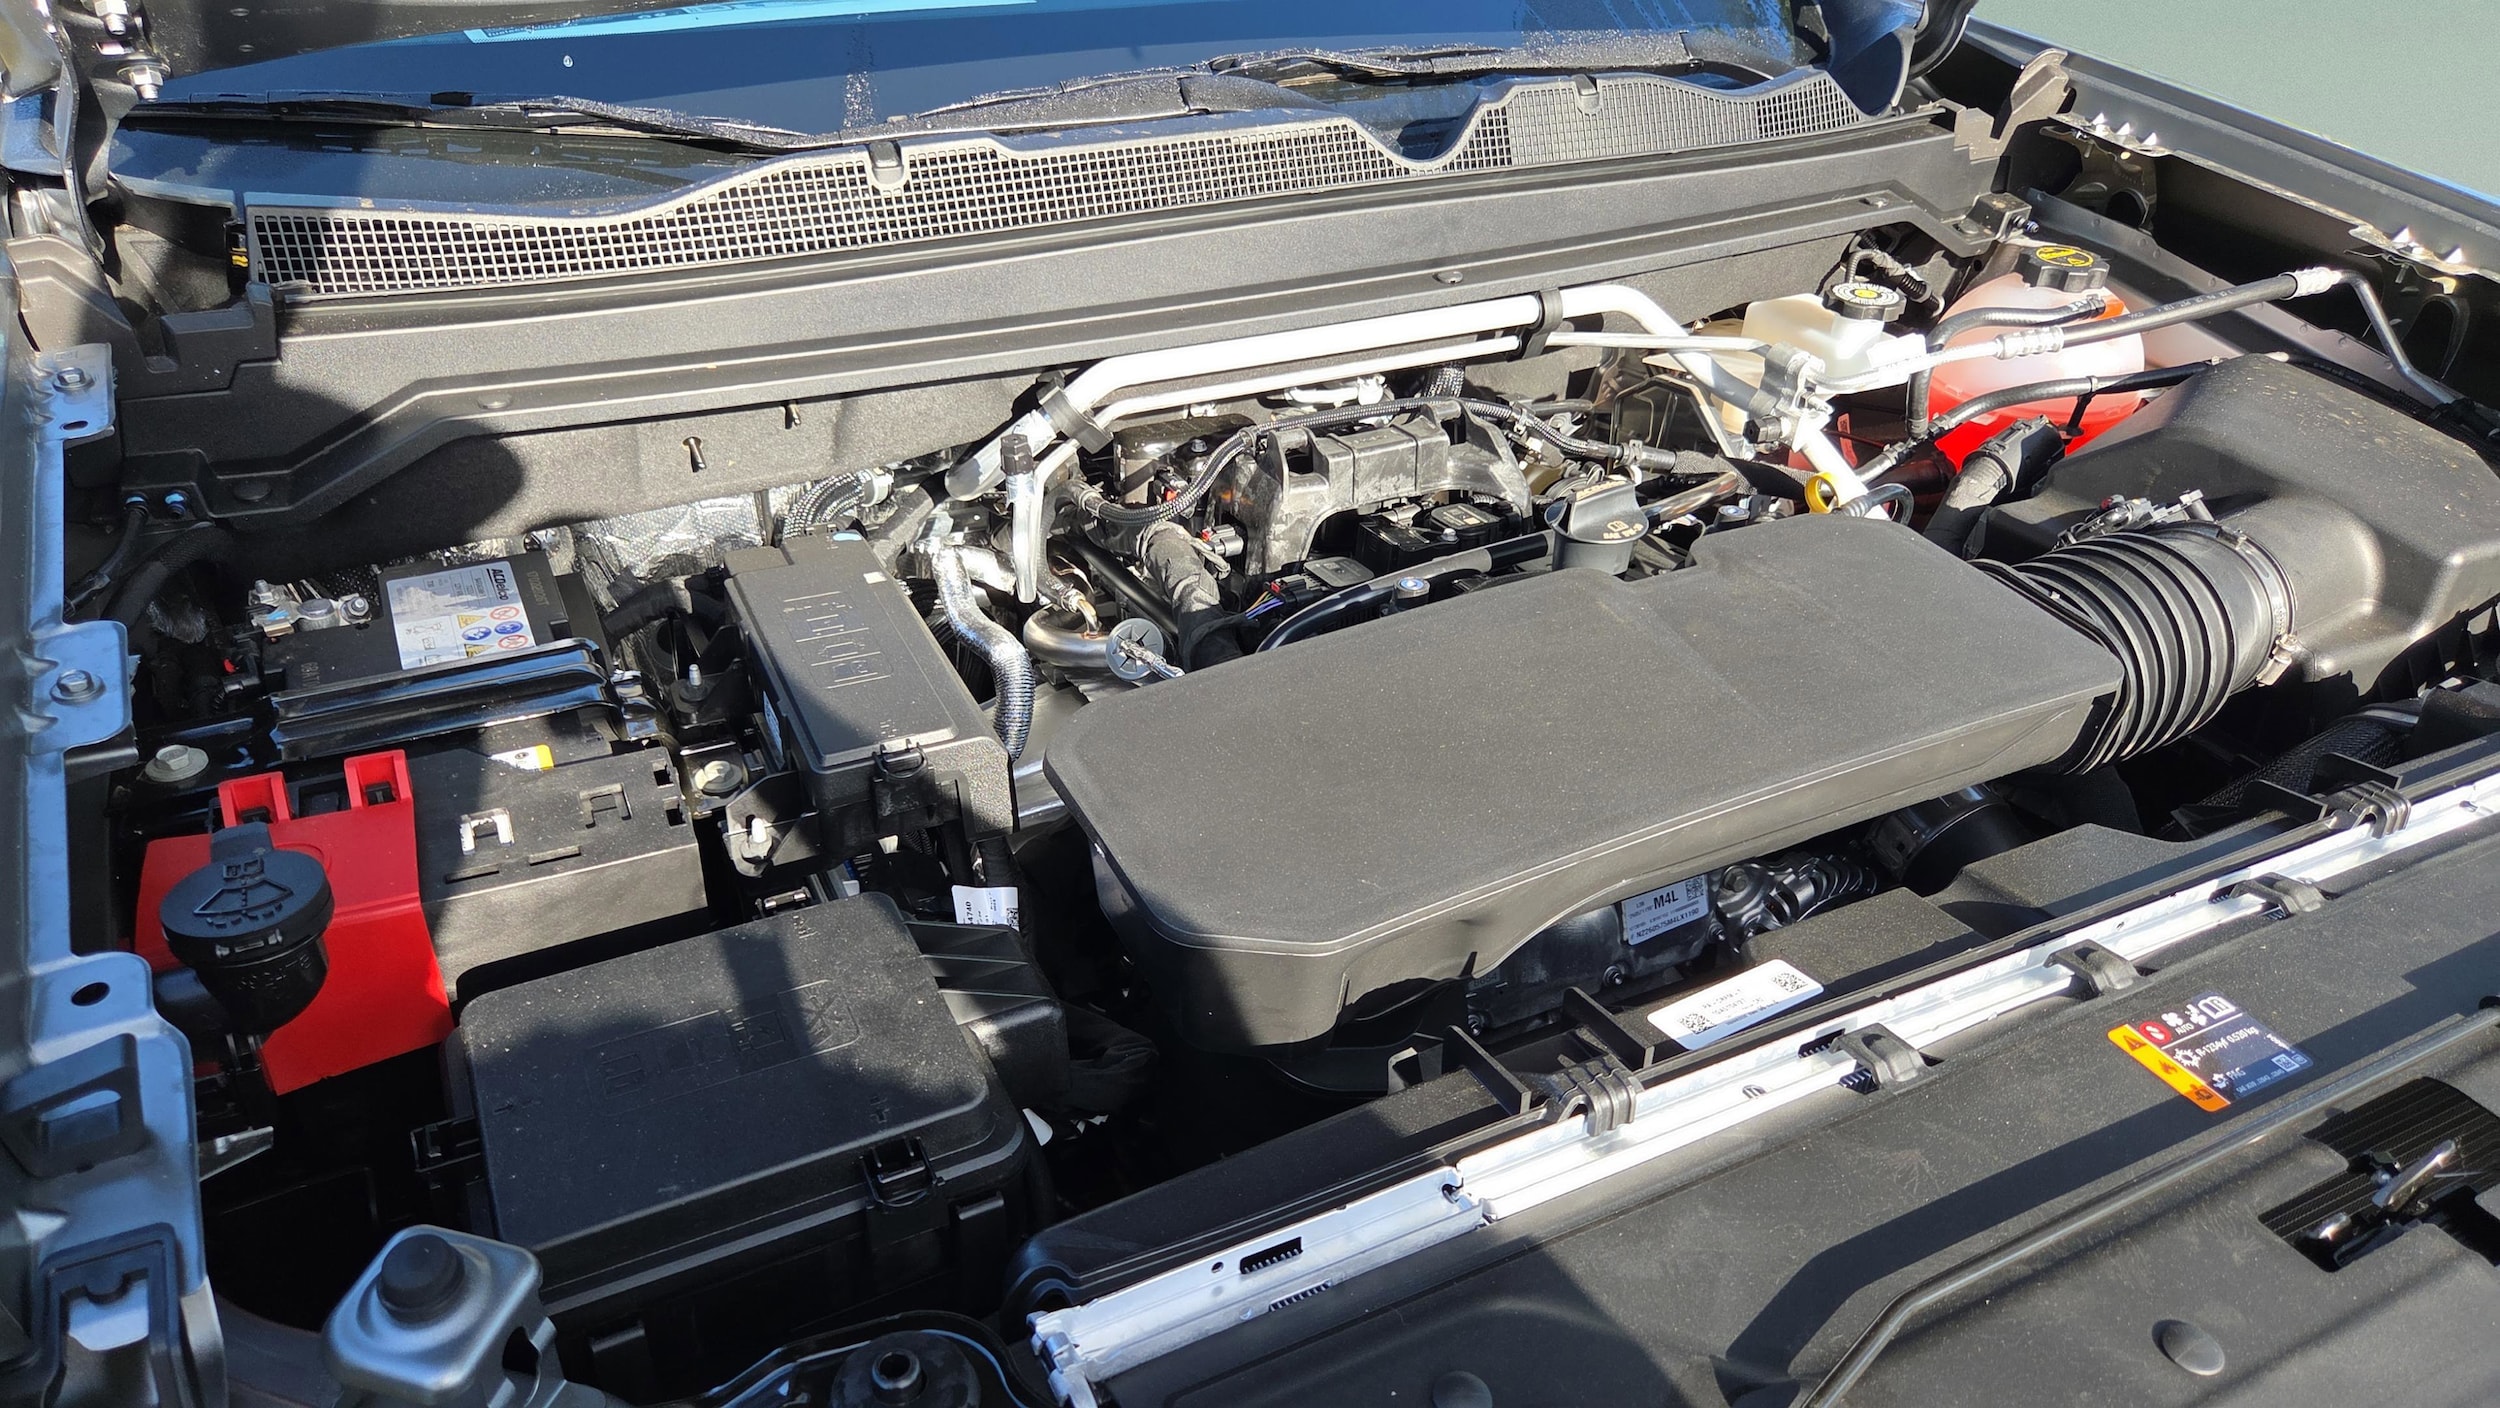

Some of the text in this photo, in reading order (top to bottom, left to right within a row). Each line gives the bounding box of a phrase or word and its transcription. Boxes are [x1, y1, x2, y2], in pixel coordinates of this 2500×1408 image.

[491, 568, 509, 600] ACDelco
[1653, 890, 1679, 910] M4L
[965, 901, 974, 925] 4740
[2175, 1022, 2195, 1036] AUTO
[2197, 1037, 2229, 1058] R-1234yf
[2226, 1067, 2247, 1081] PAG
